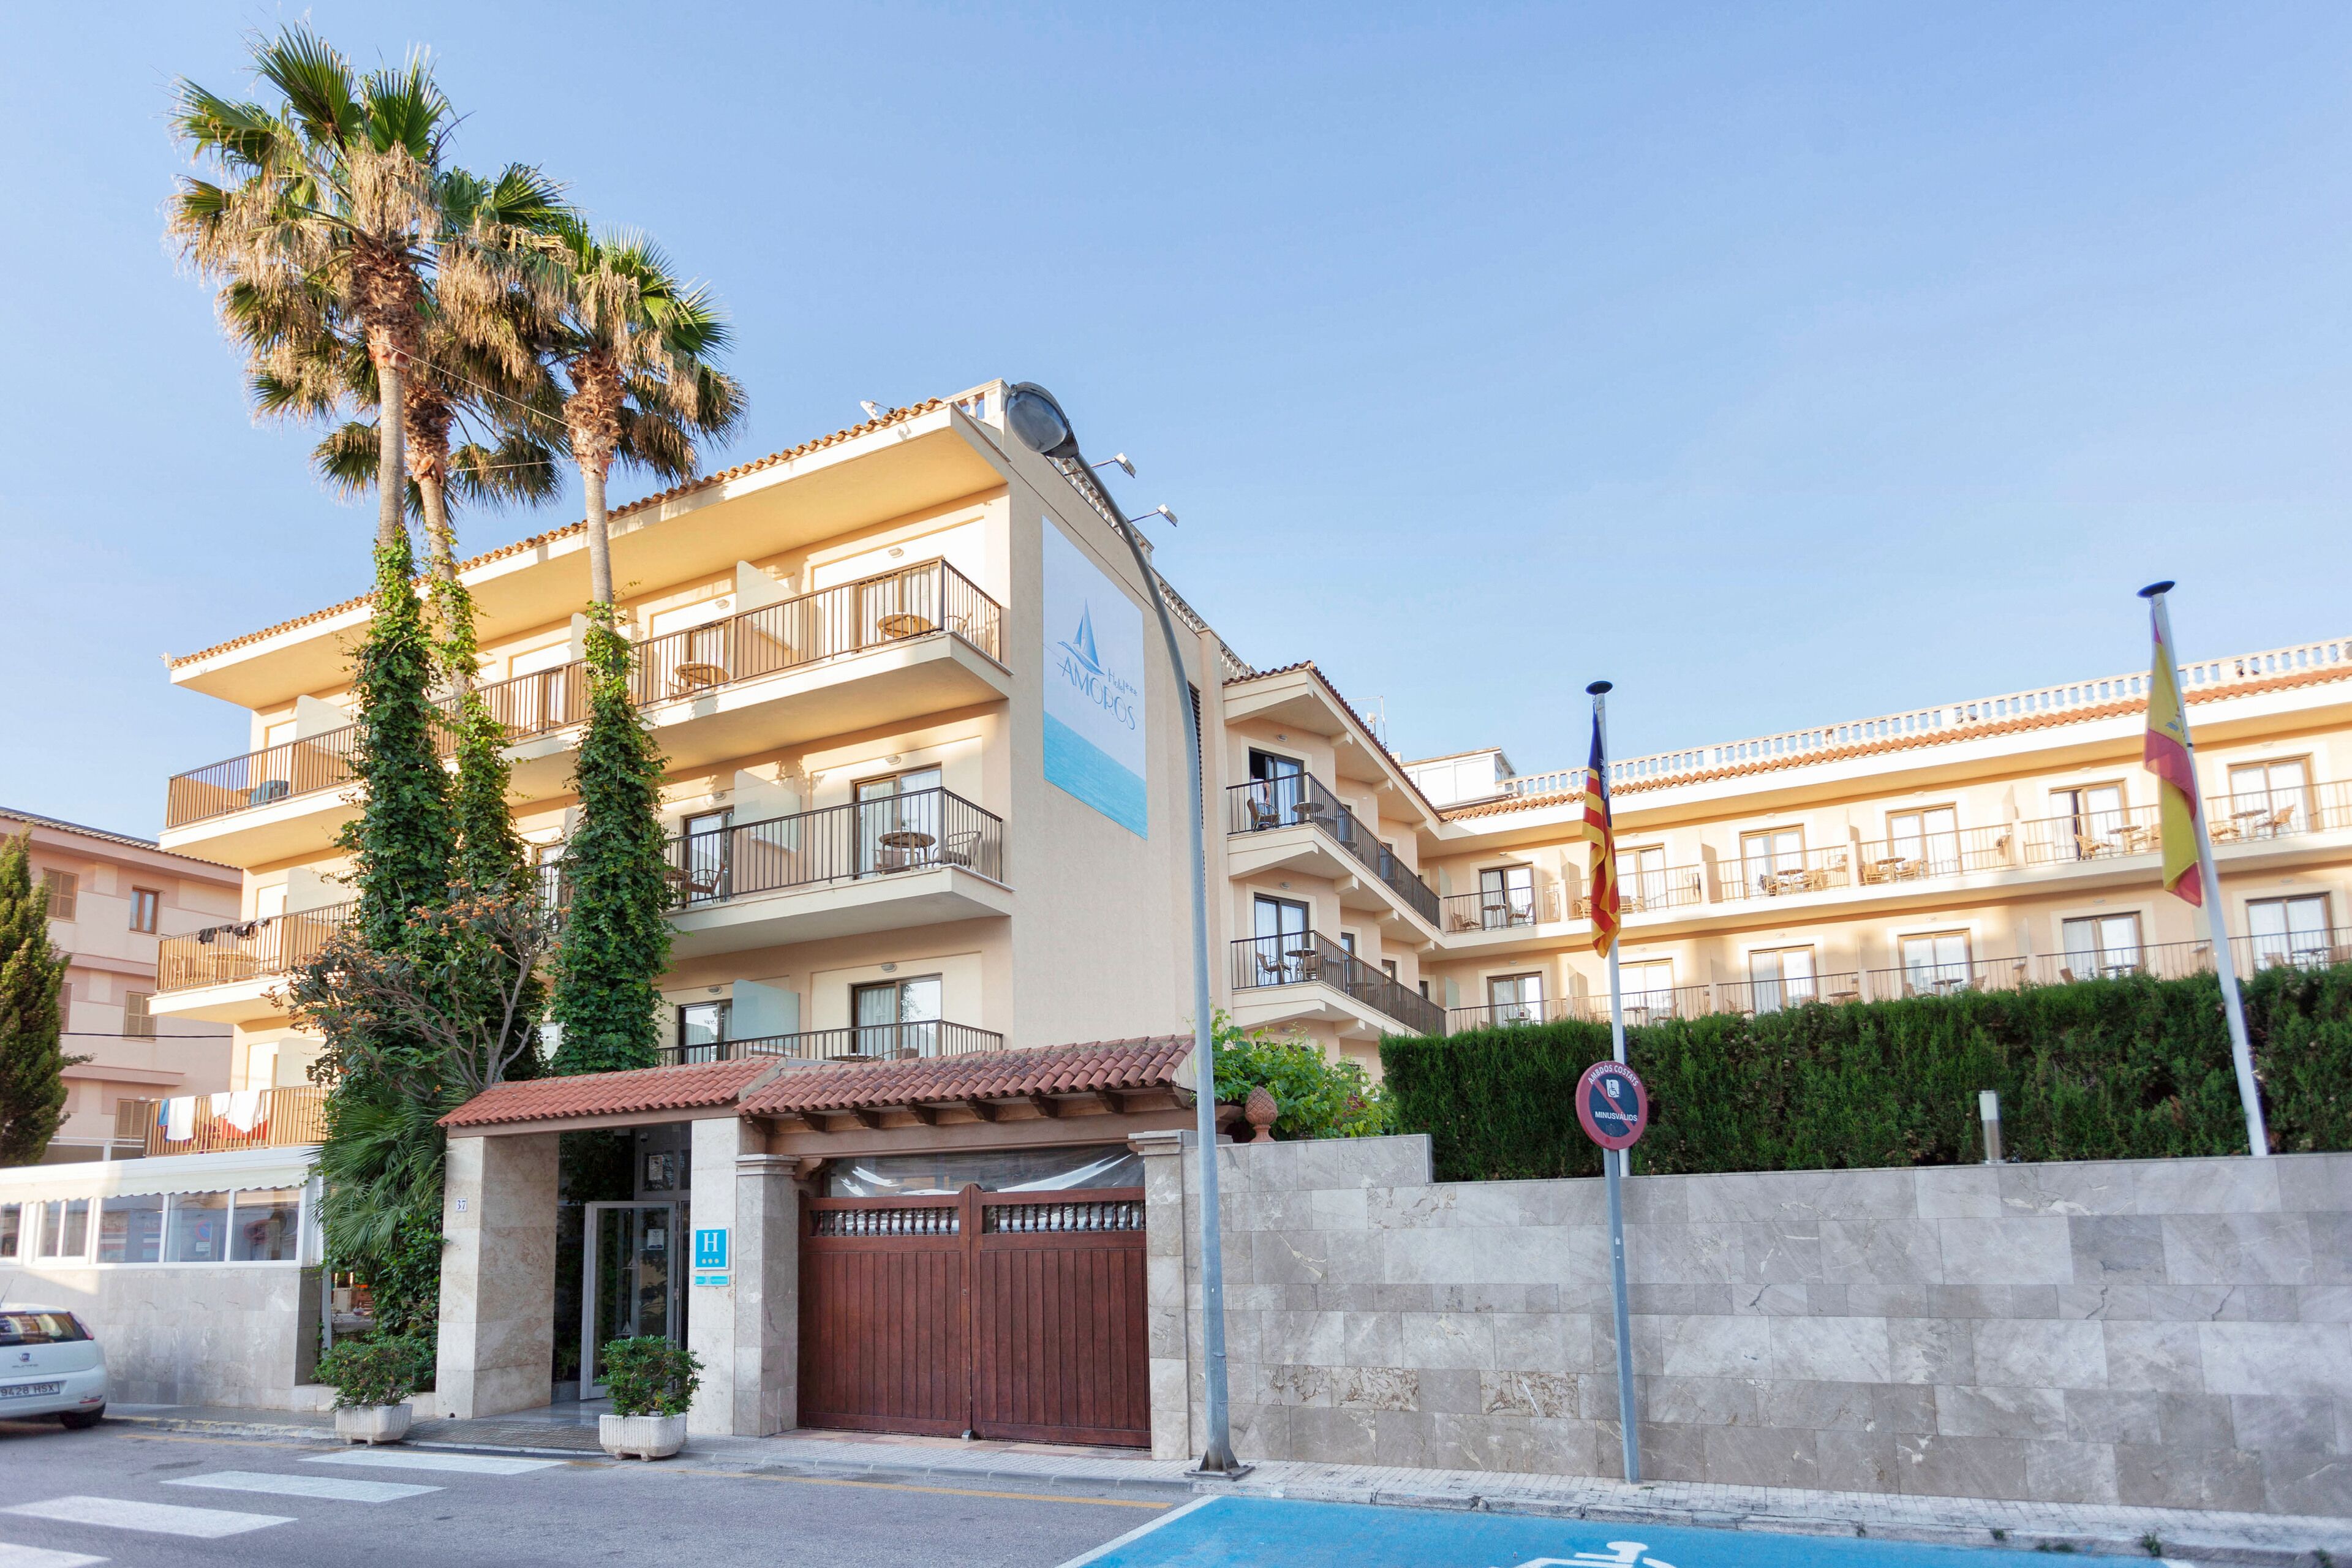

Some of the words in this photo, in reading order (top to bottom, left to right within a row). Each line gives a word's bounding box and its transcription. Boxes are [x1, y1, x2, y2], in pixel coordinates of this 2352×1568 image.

[1107, 667, 1126, 695] Hotel
[1057, 655, 1136, 730] AMOROS
[1588, 1063, 1613, 1085] AMBDÓS
[1614, 1065, 1639, 1087] COSTATS
[1594, 1111, 1638, 1121] MINUSVÁLIDS
[456, 1200, 466, 1210] 37
[702, 1232, 719, 1252] H
[1, 1386, 29, 1396] 9428
[34, 1384, 55, 1393] HSX
